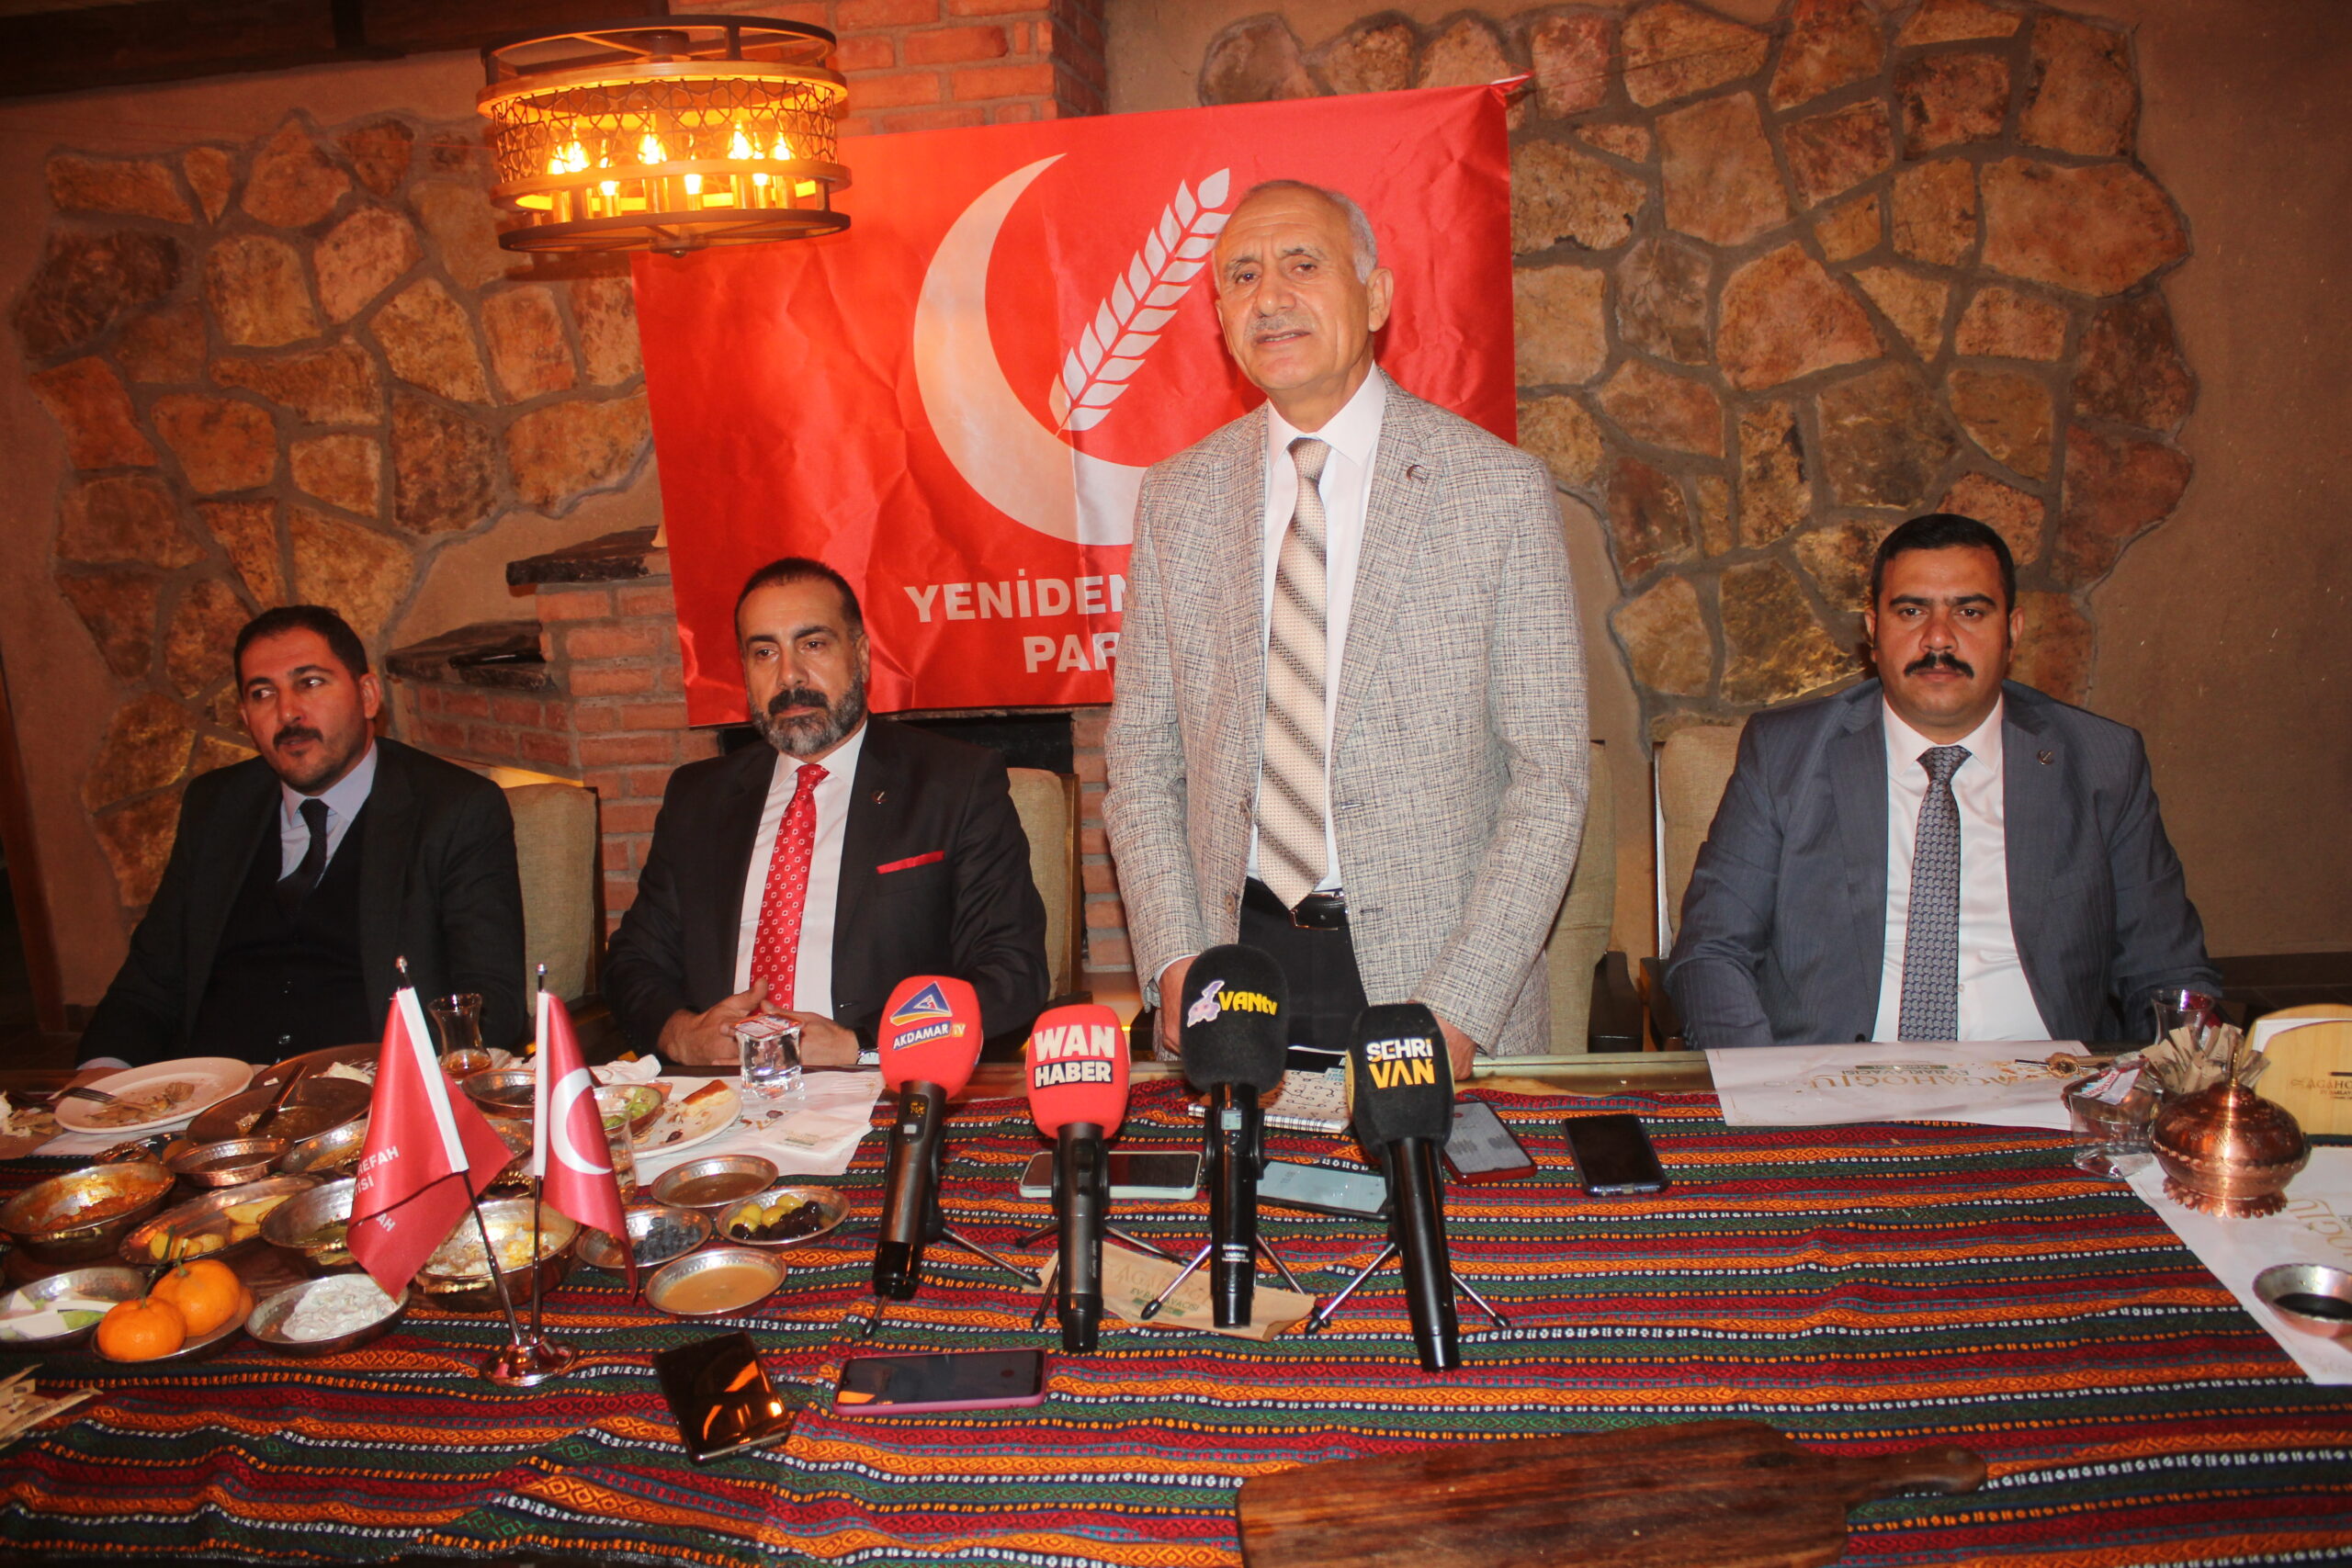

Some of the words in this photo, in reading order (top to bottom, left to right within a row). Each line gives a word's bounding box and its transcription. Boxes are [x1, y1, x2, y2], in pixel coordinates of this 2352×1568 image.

[893, 1024, 949, 1050] AKDAMAR
[952, 1023, 967, 1037] TV
[1035, 1024, 1115, 1062] WAN
[1035, 1061, 1113, 1088] HABER
[1369, 1059, 1435, 1089] VAN
[356, 1145, 400, 1176] REFAH
